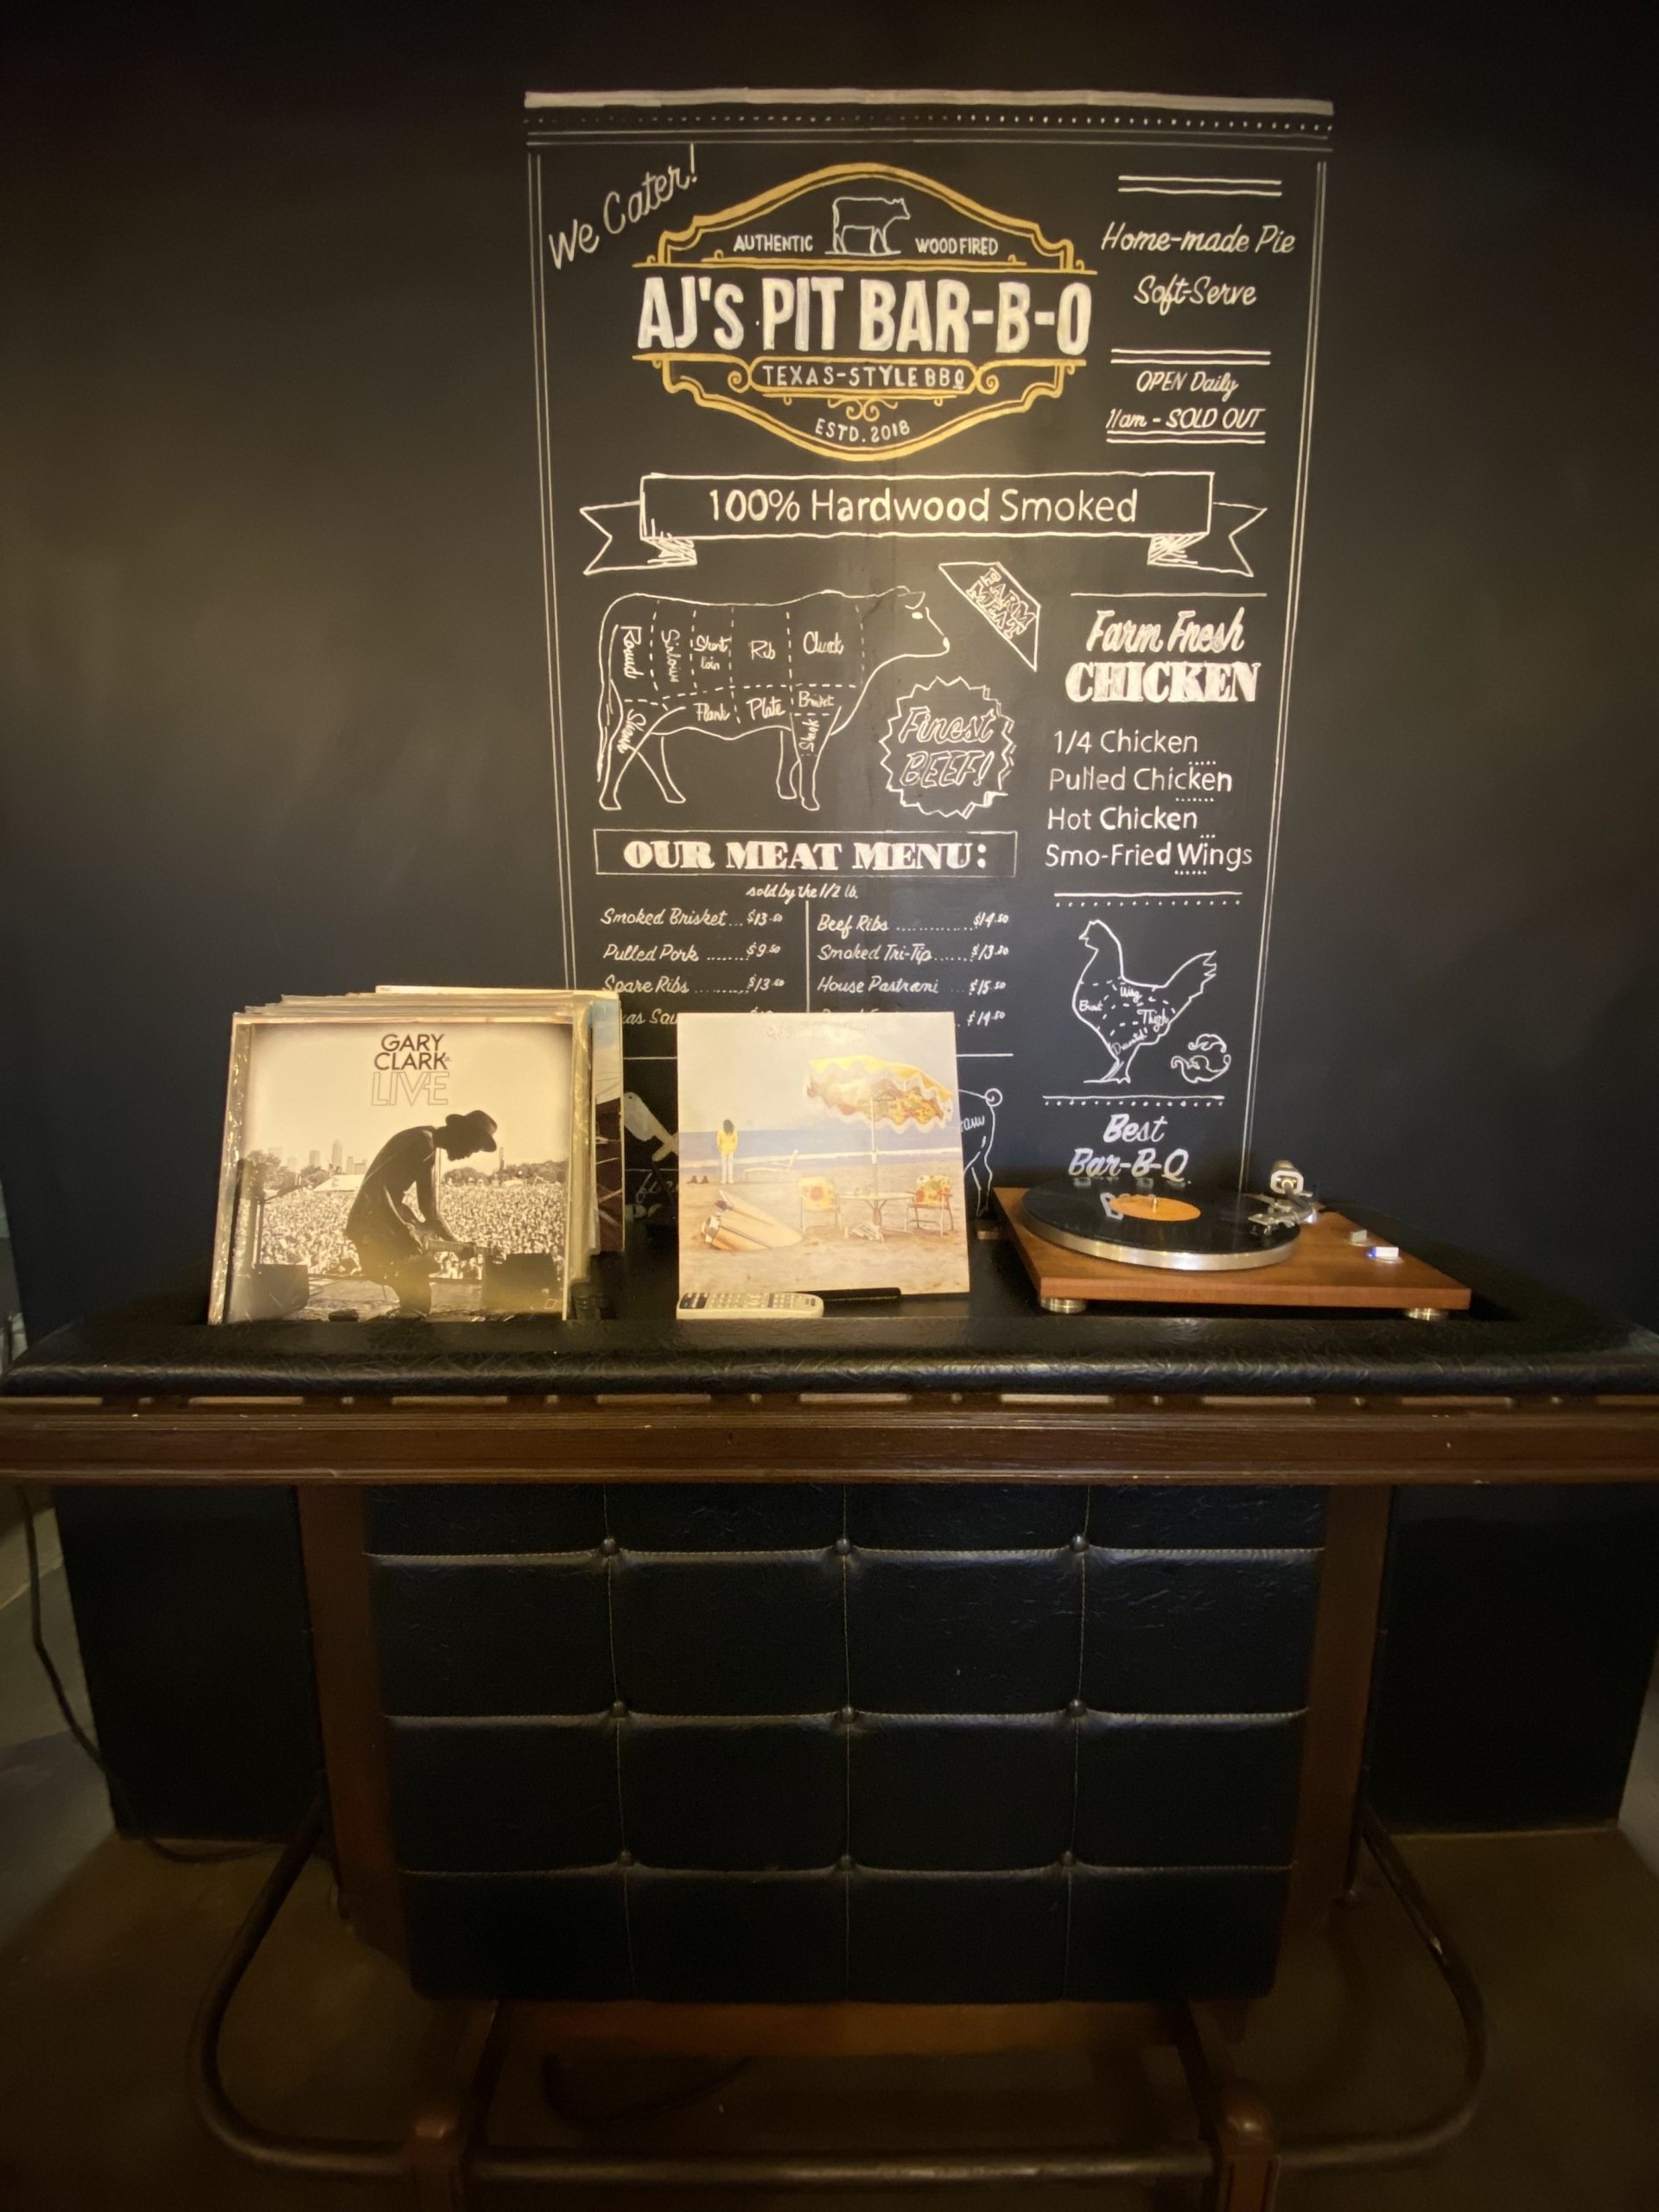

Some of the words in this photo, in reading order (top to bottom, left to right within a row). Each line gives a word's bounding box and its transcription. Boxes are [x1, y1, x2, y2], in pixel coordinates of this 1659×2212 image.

[549, 219, 601, 270] We
[603, 143, 697, 235] Cater!
[734, 234, 814, 253] AUTHENTIC
[1101, 221, 1249, 254] Home-made
[1255, 224, 1296, 254] Pie
[1133, 273, 1257, 316] Soft-Serve
[637, 276, 745, 350] AJ'S
[761, 276, 844, 352] PIT
[762, 364, 918, 388] TEXAS-STYLE
[924, 366, 966, 390] BBQ
[1135, 370, 1187, 393] OPEN
[1190, 371, 1240, 403] Daily
[1105, 408, 1148, 429] 11am
[1165, 407, 1219, 429] SOLD
[1222, 407, 1267, 429] OUT
[709, 487, 801, 522] 100%
[812, 486, 990, 523] Hardwood
[1000, 487, 1139, 523] Smoked
[1085, 608, 1165, 653] Farm
[1167, 606, 1246, 654] Fresh
[750, 639, 776, 661] Rib
[1065, 660, 1262, 703] CHICKEN
[746, 695, 786, 721] Plate
[898, 704, 997, 745] Finest
[1053, 728, 1093, 755] 1/4
[1100, 728, 1198, 753] Chicken
[899, 749, 995, 789] BEEF!
[1048, 766, 1126, 791] Pulled
[1133, 766, 1233, 792] Chicken
[1047, 806, 1092, 830] Hot
[1099, 804, 1198, 831] Chicken
[623, 840, 715, 869] OUR
[725, 841, 843, 871] MEAT
[851, 842, 988, 871] MENU:
[1045, 841, 1172, 868] Smo-Fried
[1177, 841, 1253, 873] Wings
[745, 883, 779, 899] sold
[778, 881, 797, 906] by
[798, 882, 817, 899] the
[818, 882, 842, 899] 1/2
[600, 906, 666, 926] Smoked
[669, 906, 728, 927] Brisket
[817, 912, 854, 940] Beef
[855, 913, 889, 932] Ribs
[602, 943, 656, 963] Pulled
[659, 943, 700, 963] Pork
[817, 943, 880, 962] Smoked
[883, 942, 933, 965] Tri-Tip
[654, 975, 690, 994] Ribs
[817, 975, 865, 994] House
[380, 1033, 446, 1052] GARY
[373, 1052, 448, 1071] CLARK
[371, 1071, 451, 1107] LIVE
[1103, 1112, 1169, 1143] Best
